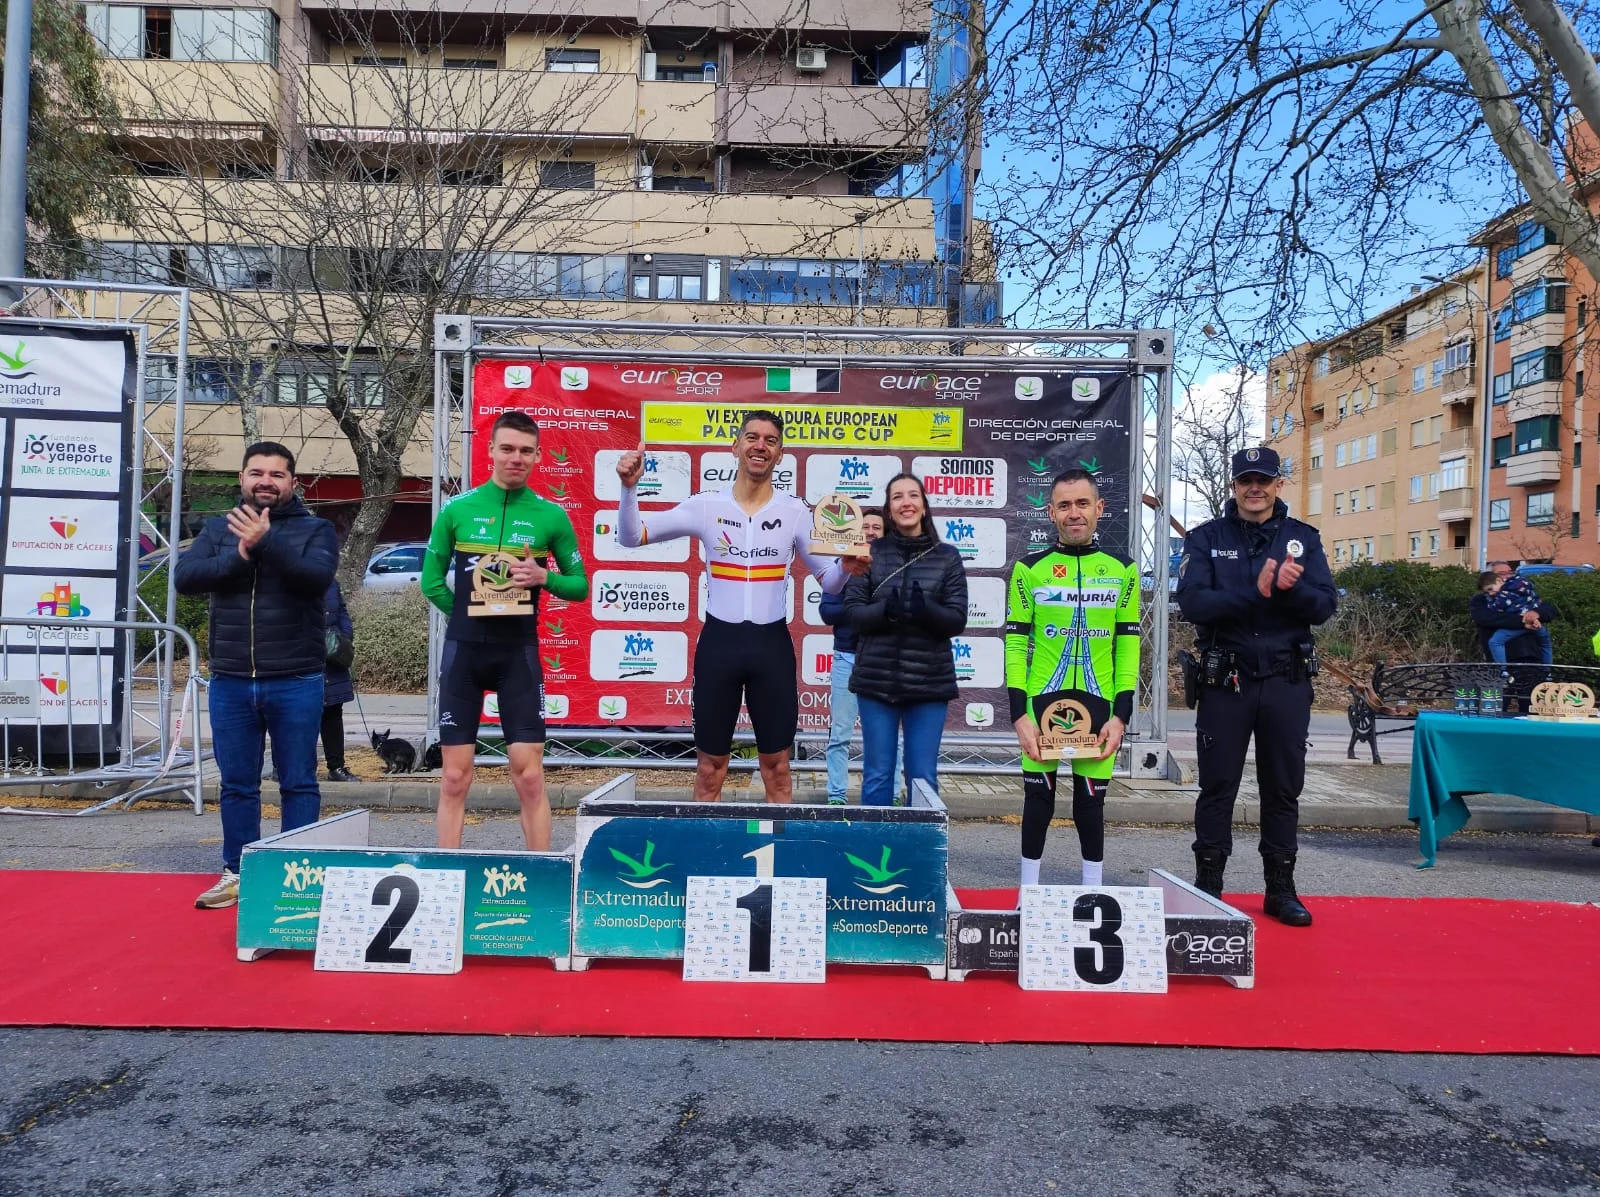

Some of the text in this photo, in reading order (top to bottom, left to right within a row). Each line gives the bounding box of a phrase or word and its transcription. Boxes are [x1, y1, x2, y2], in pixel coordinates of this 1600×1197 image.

[880, 373, 982, 392] euroace
[676, 387, 722, 395] SPORT
[935, 391, 981, 401] SPORT
[11, 397, 45, 406] DEPORTE
[563, 408, 635, 419] GENERAL
[706, 409, 719, 424] VI
[825, 411, 897, 427] EUROPEAN
[968, 417, 1124, 429] DIRECCIÓN GENERAL
[853, 425, 894, 442] CUP
[990, 432, 1097, 441] DE DEPORTES
[21, 464, 111, 477] JUNTA DE EXTREMADURA
[539, 465, 584, 474] Extremadura
[940, 458, 994, 475] SOMOS
[923, 475, 995, 497] DEPORTE
[12, 541, 62, 550] DIPUTACIÓN
[76, 543, 113, 552] CÁCERES
[728, 546, 779, 559] Cofidis
[624, 583, 667, 591] fundación
[473, 591, 528, 600] Extremadura
[623, 600, 686, 612] ydeporte
[1041, 735, 1097, 745] Extremadura
[481, 897, 527, 905] Extremadura
[365, 874, 420, 963] 2
[736, 884, 773, 973] 1
[832, 919, 929, 938] #SomosDeporte
[1072, 893, 1124, 985] 3
[493, 942, 524, 950] DEPORTES
[1189, 953, 1245, 964] SPORT
